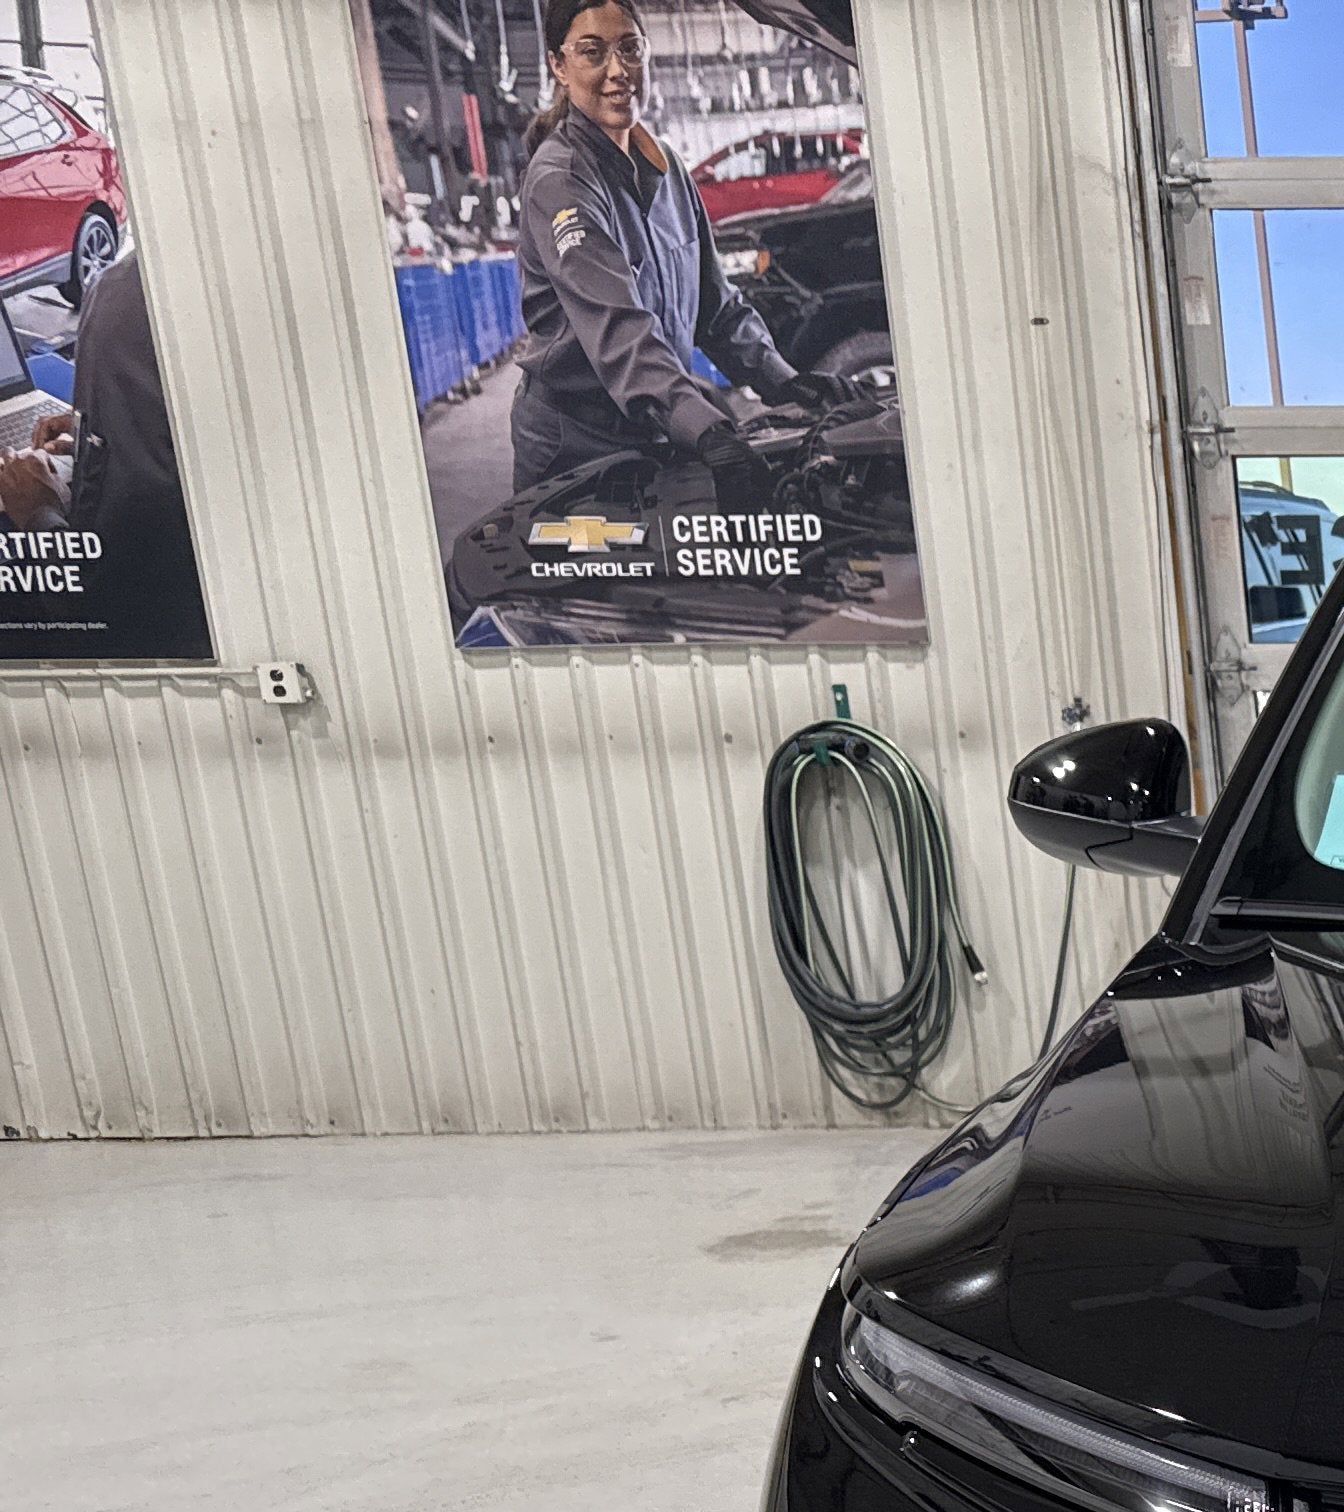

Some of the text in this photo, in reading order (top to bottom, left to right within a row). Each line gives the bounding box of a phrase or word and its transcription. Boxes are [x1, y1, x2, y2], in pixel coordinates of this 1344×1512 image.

[672, 514, 822, 543] CERTIFIED
[531, 562, 655, 577] CHEVROLET
[676, 548, 802, 576] SERVICE
[0, 565, 84, 592] RVICE
